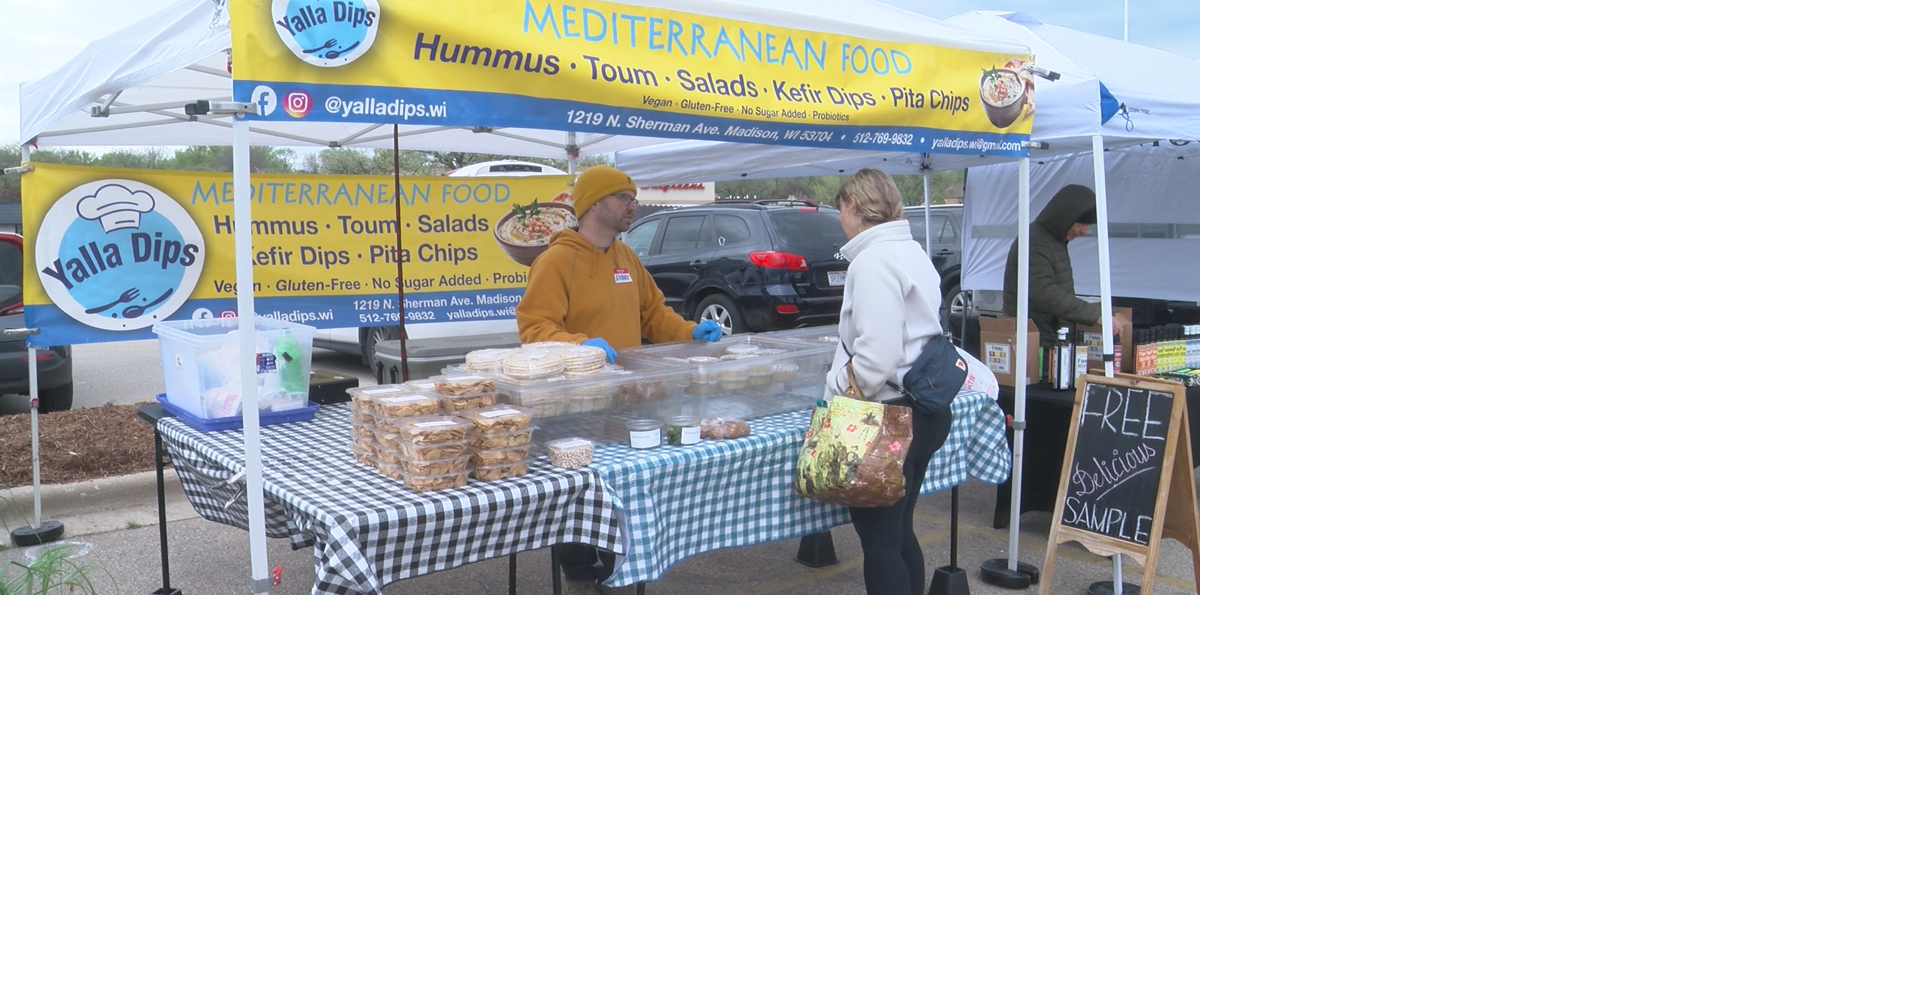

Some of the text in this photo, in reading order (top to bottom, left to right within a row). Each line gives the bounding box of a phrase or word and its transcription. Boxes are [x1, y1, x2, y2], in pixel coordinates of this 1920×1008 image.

[276, 1, 376, 36] Yalla Dips
[522, 0, 912, 76] MEDITERRANEAN FOOD
[413, 32, 970, 115] Hummus Toum Salads Kefir Dips Pita Chips
[325, 96, 447, 120] @yalladips.wi
[642, 95, 850, 122] Vegan Gluten-Free No Sugar Added Probiotics
[566, 109, 603, 126] 1219
[606, 114, 621, 128] N.
[625, 115, 691, 133] Sherman
[692, 122, 720, 136] Ave.
[724, 125, 779, 141] Madison,
[783, 129, 800, 140] WI
[799, 131, 833, 141] 53704
[852, 132, 914, 146] 512-769-9832
[441, 183, 511, 204] FOOD
[337, 215, 399, 234] Toum
[418, 213, 489, 234] Salads
[41, 232, 199, 290] Yalla Dips
[251, 243, 478, 269] efir Dips Pita Chips
[275, 278, 361, 292] Gluten-Free
[372, 277, 391, 290] No
[438, 273, 481, 287] Added
[353, 300, 380, 311] 1219
[382, 298, 395, 310] N.
[450, 295, 474, 307] Ave.
[1081, 383, 1174, 440] FREE
[1072, 443, 1156, 496] Delicious
[1064, 496, 1153, 544] SAMPLE
